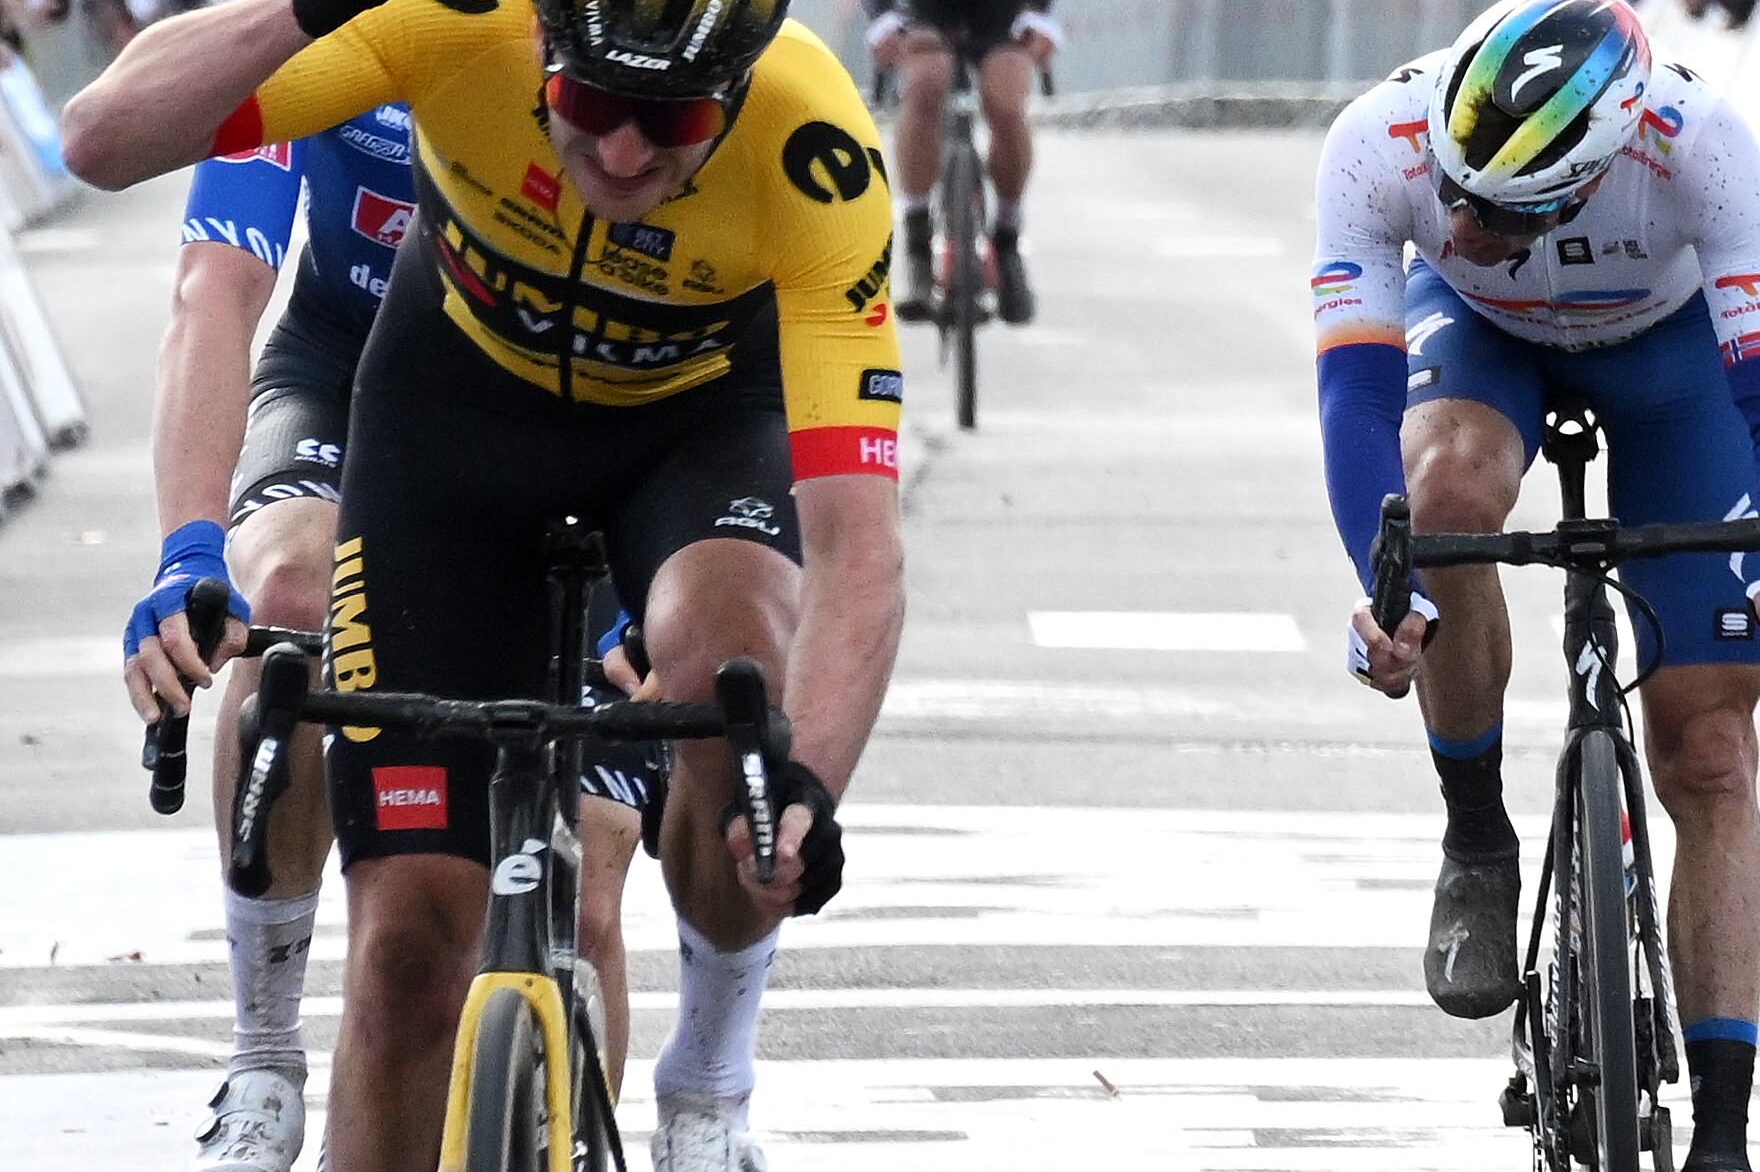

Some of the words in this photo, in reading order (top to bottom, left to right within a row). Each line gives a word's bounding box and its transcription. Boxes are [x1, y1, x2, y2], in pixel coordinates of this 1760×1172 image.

[604, 49, 672, 72] LAZER
[238, 737, 279, 844] SRAM
[378, 788, 442, 808] HEMA
